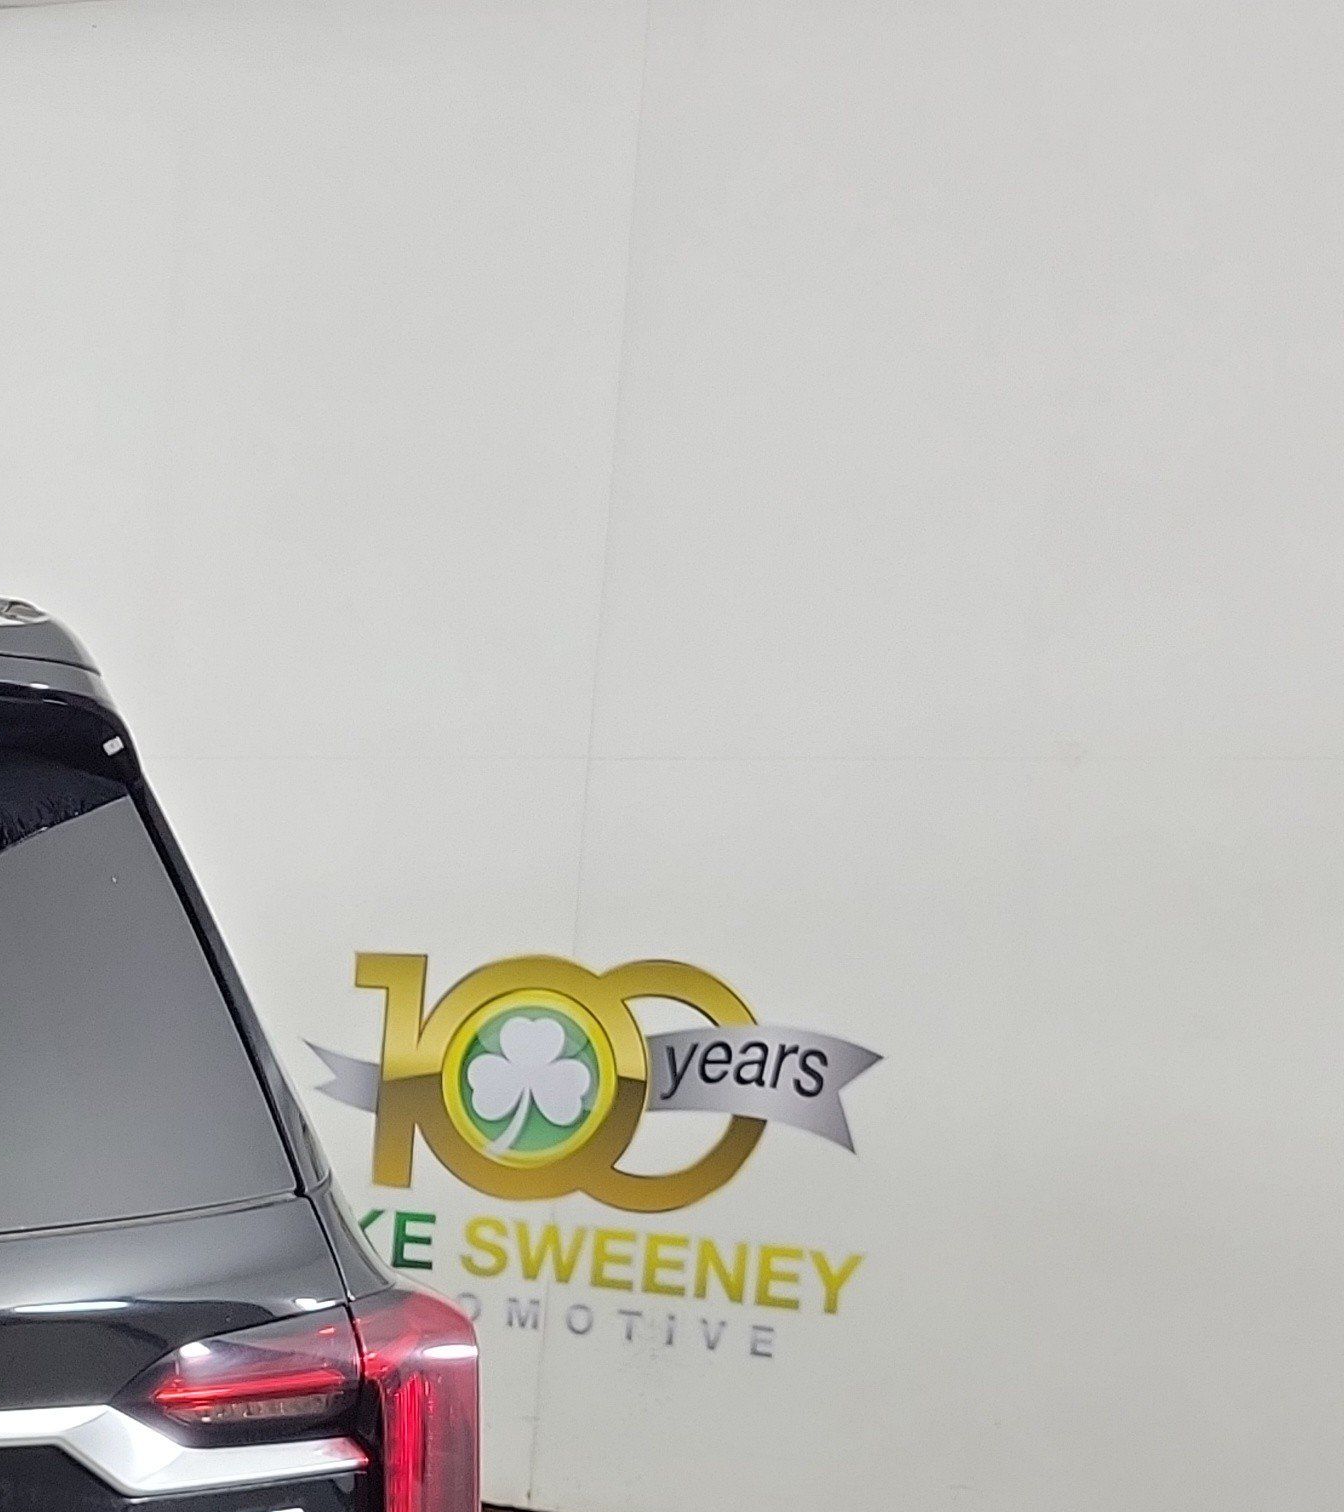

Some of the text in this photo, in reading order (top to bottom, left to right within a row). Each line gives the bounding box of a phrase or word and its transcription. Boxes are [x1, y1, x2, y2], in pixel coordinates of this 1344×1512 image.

[355, 952, 829, 1213] 100 years
[460, 1215, 864, 1315] SWEENEY
[455, 1292, 777, 1358] OMOTIVE
